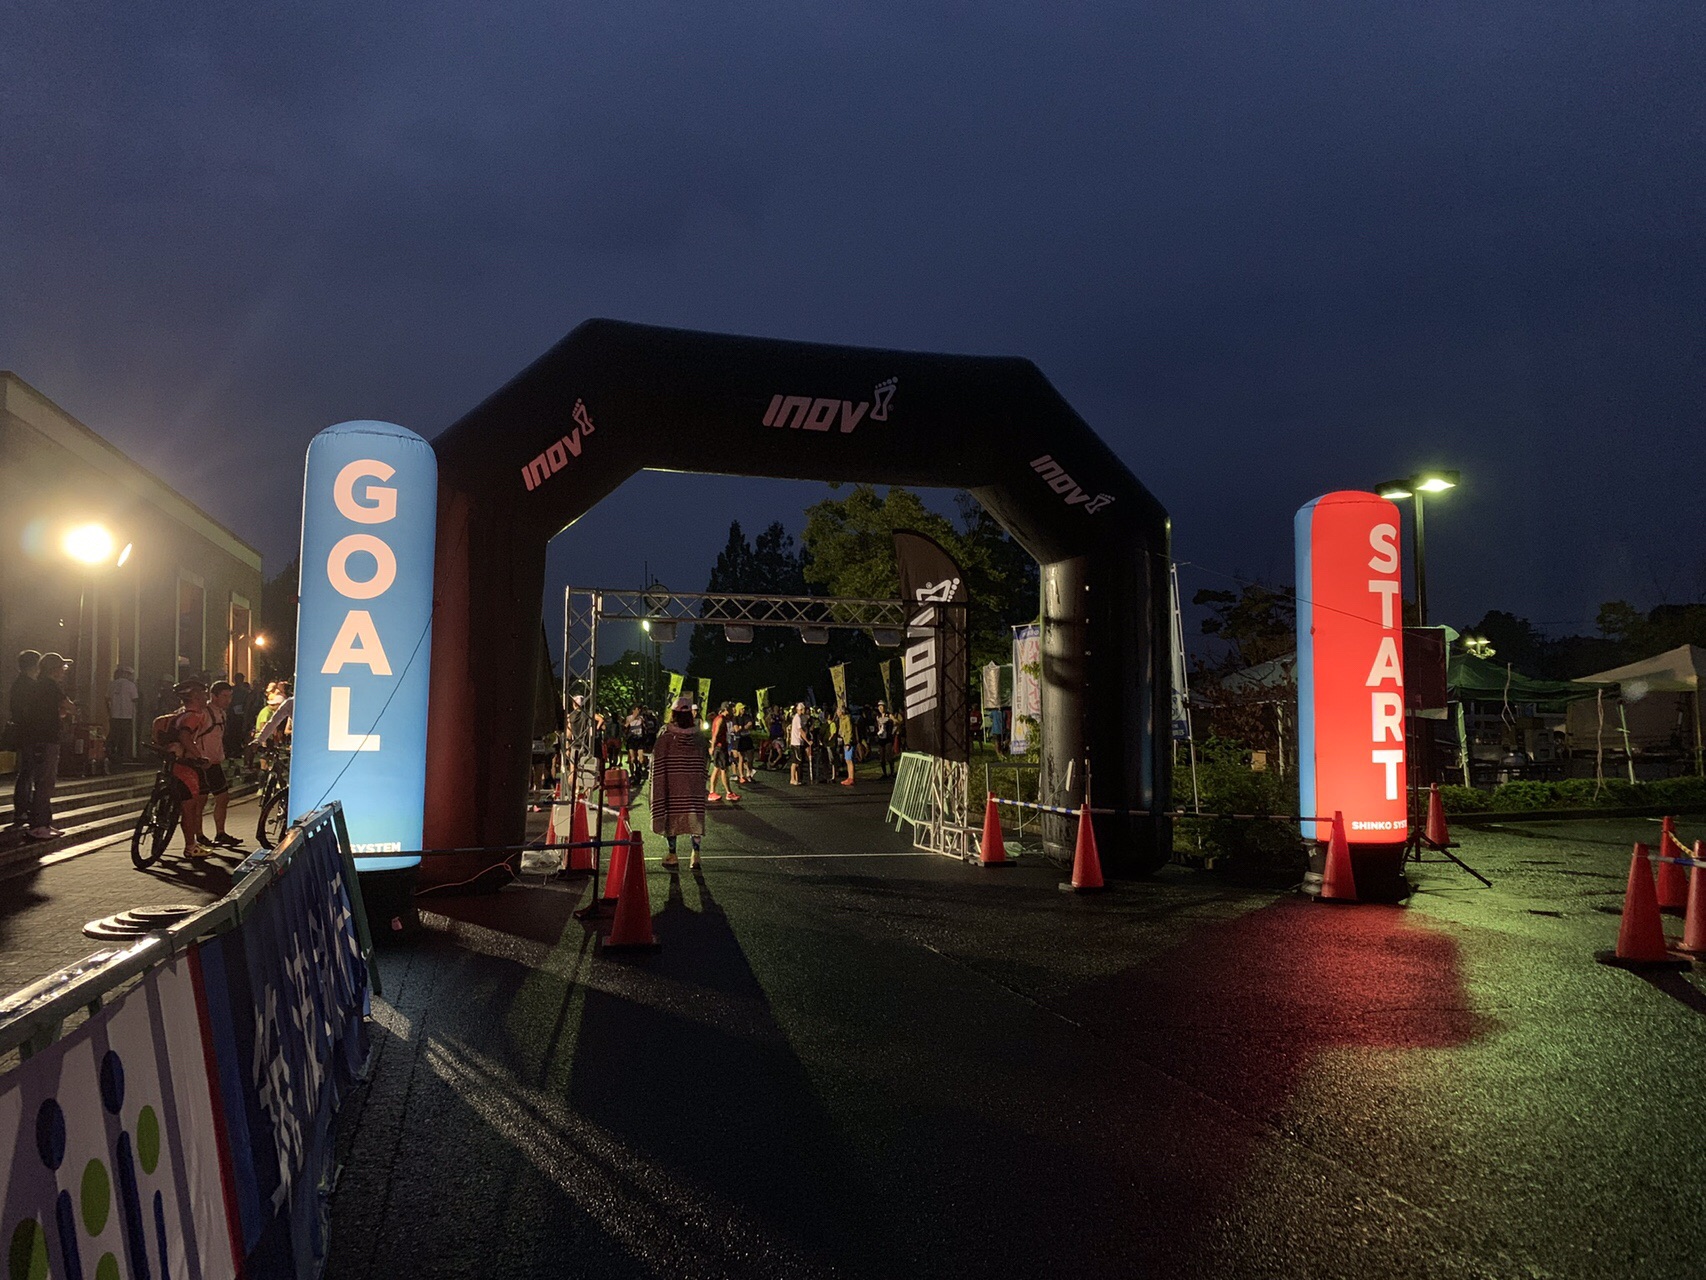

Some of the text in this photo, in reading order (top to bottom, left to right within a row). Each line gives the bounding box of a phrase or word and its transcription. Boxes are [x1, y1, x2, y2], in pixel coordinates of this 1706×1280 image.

[320, 458, 398, 752] GOAL
[1365, 523, 1403, 800] START
[1351, 821, 1392, 830] SHINKO
